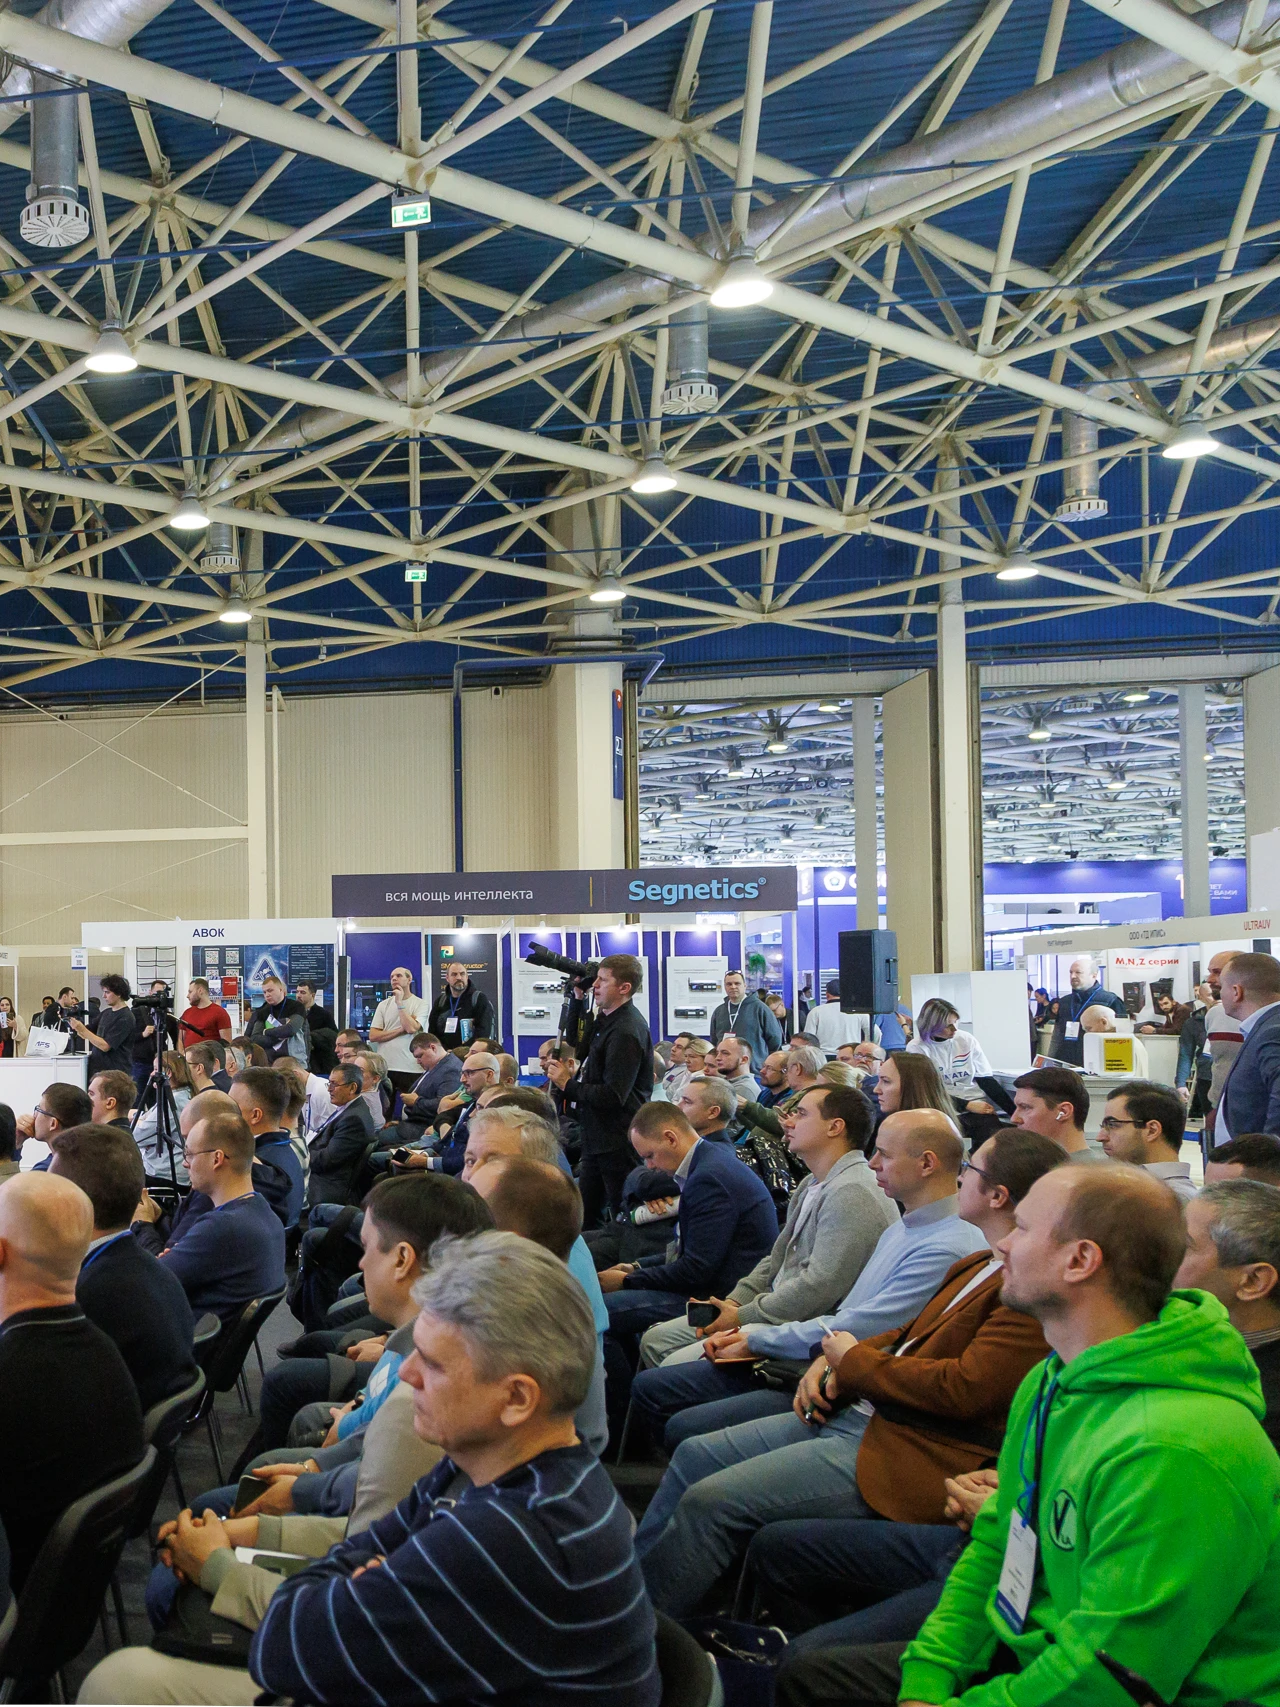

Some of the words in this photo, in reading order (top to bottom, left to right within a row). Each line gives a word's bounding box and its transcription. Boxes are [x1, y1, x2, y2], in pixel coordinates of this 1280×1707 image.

[385, 892, 407, 902] вся
[411, 891, 451, 903] мощь
[454, 888, 534, 901] интеллекта
[192, 928, 225, 938] АВОК
[1129, 931, 1139, 940] ООО
[1148, 958, 1179, 967] серии
